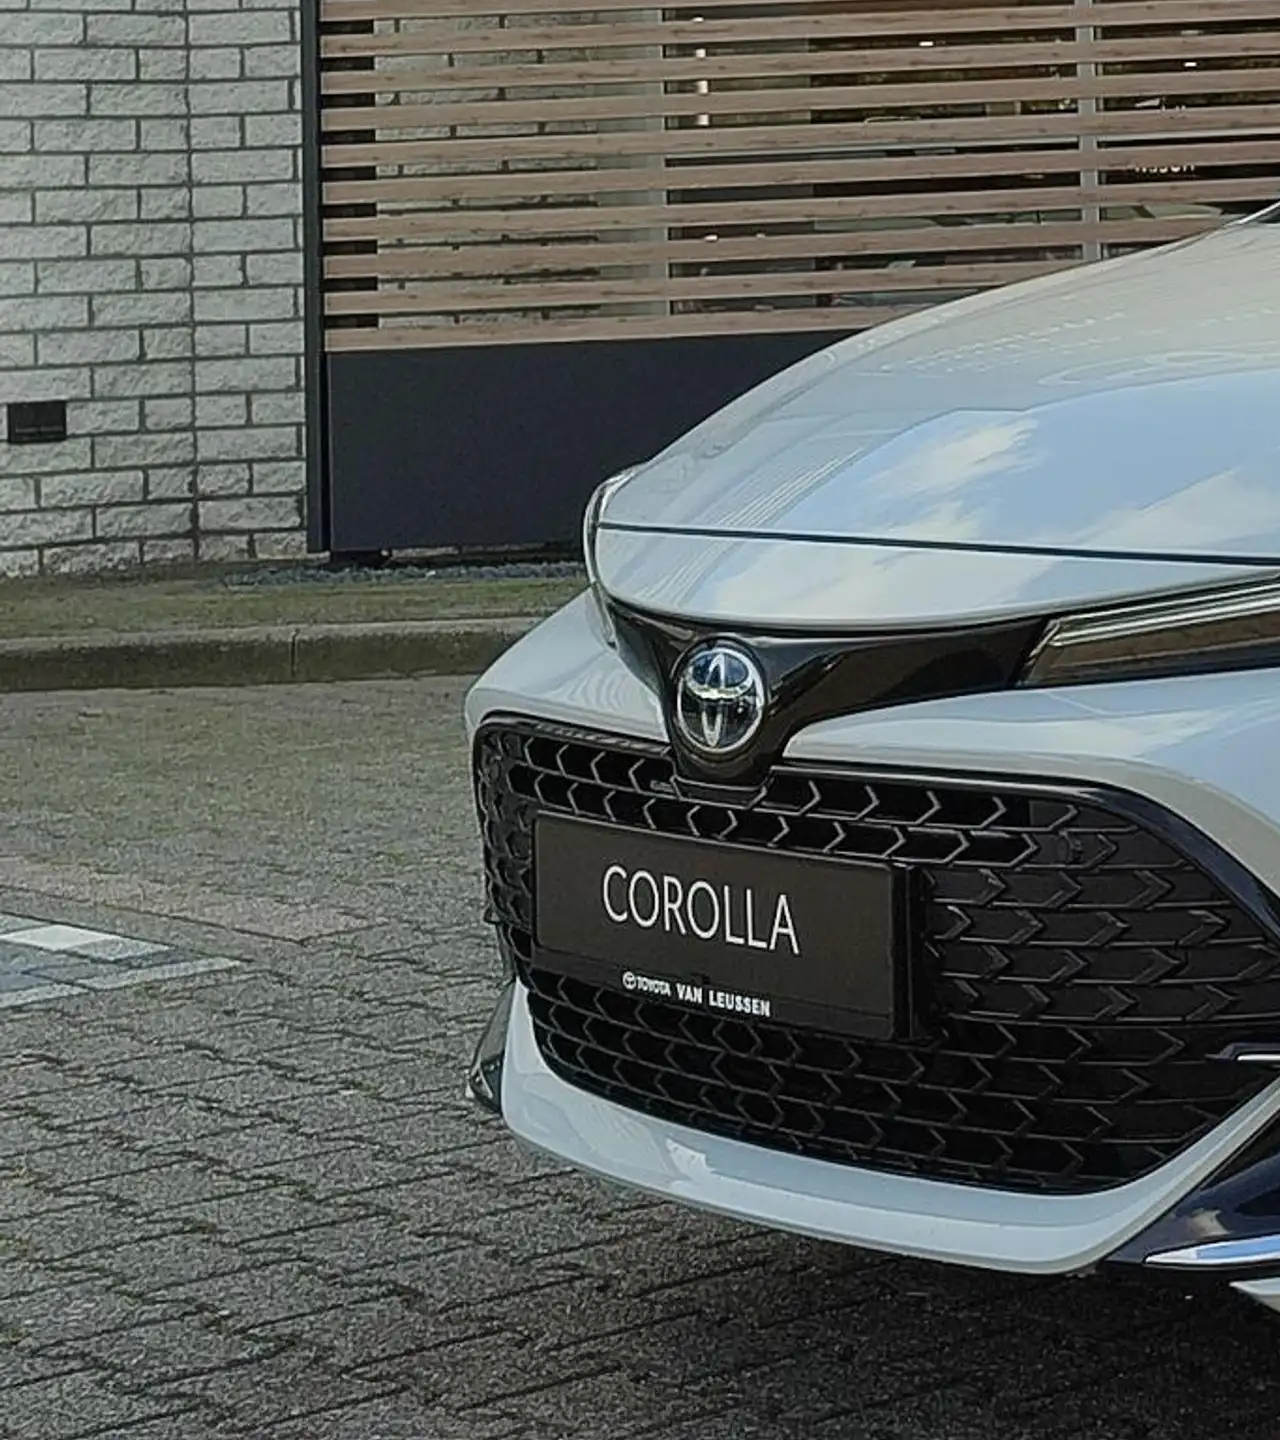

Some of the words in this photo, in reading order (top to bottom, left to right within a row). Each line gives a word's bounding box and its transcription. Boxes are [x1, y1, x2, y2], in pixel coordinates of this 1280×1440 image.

[602, 865, 801, 956] COROLLA
[636, 974, 672, 997] TOYOTA
[675, 982, 703, 1004] VAN
[708, 989, 771, 1018] LEUSSEN
